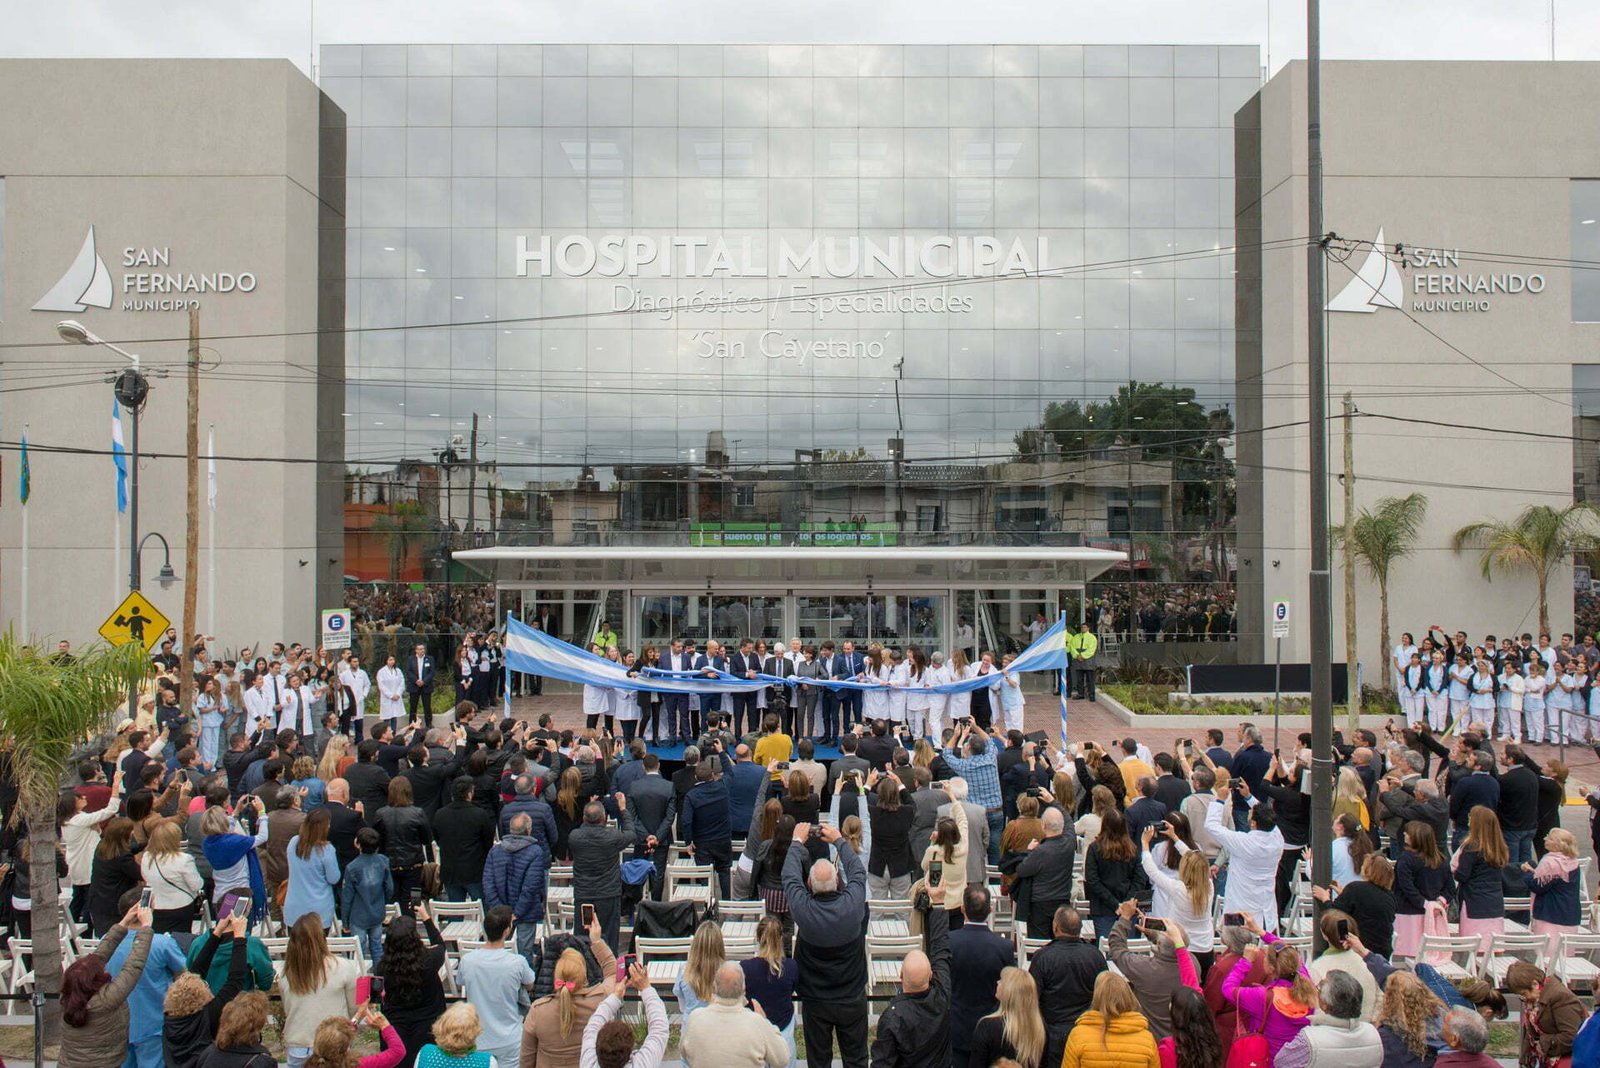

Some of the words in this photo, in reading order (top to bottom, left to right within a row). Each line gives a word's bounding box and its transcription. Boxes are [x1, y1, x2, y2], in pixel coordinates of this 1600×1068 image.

[122, 247, 170, 267] SAN
[515, 235, 767, 277] HOSPITAL
[777, 236, 1063, 278] MUNICIPAL
[1412, 248, 1460, 269] SAN
[123, 272, 257, 293] FERNANDO
[1413, 273, 1546, 294] FERNANDO
[122, 299, 201, 312] MUNICIPIO
[611, 283, 764, 321] Diagnóstico
[790, 283, 974, 321] Especialidades
[1413, 300, 1490, 312] MUNICIPIO
[1279, 606, 1284, 616] E
[332, 618, 341, 628] E
